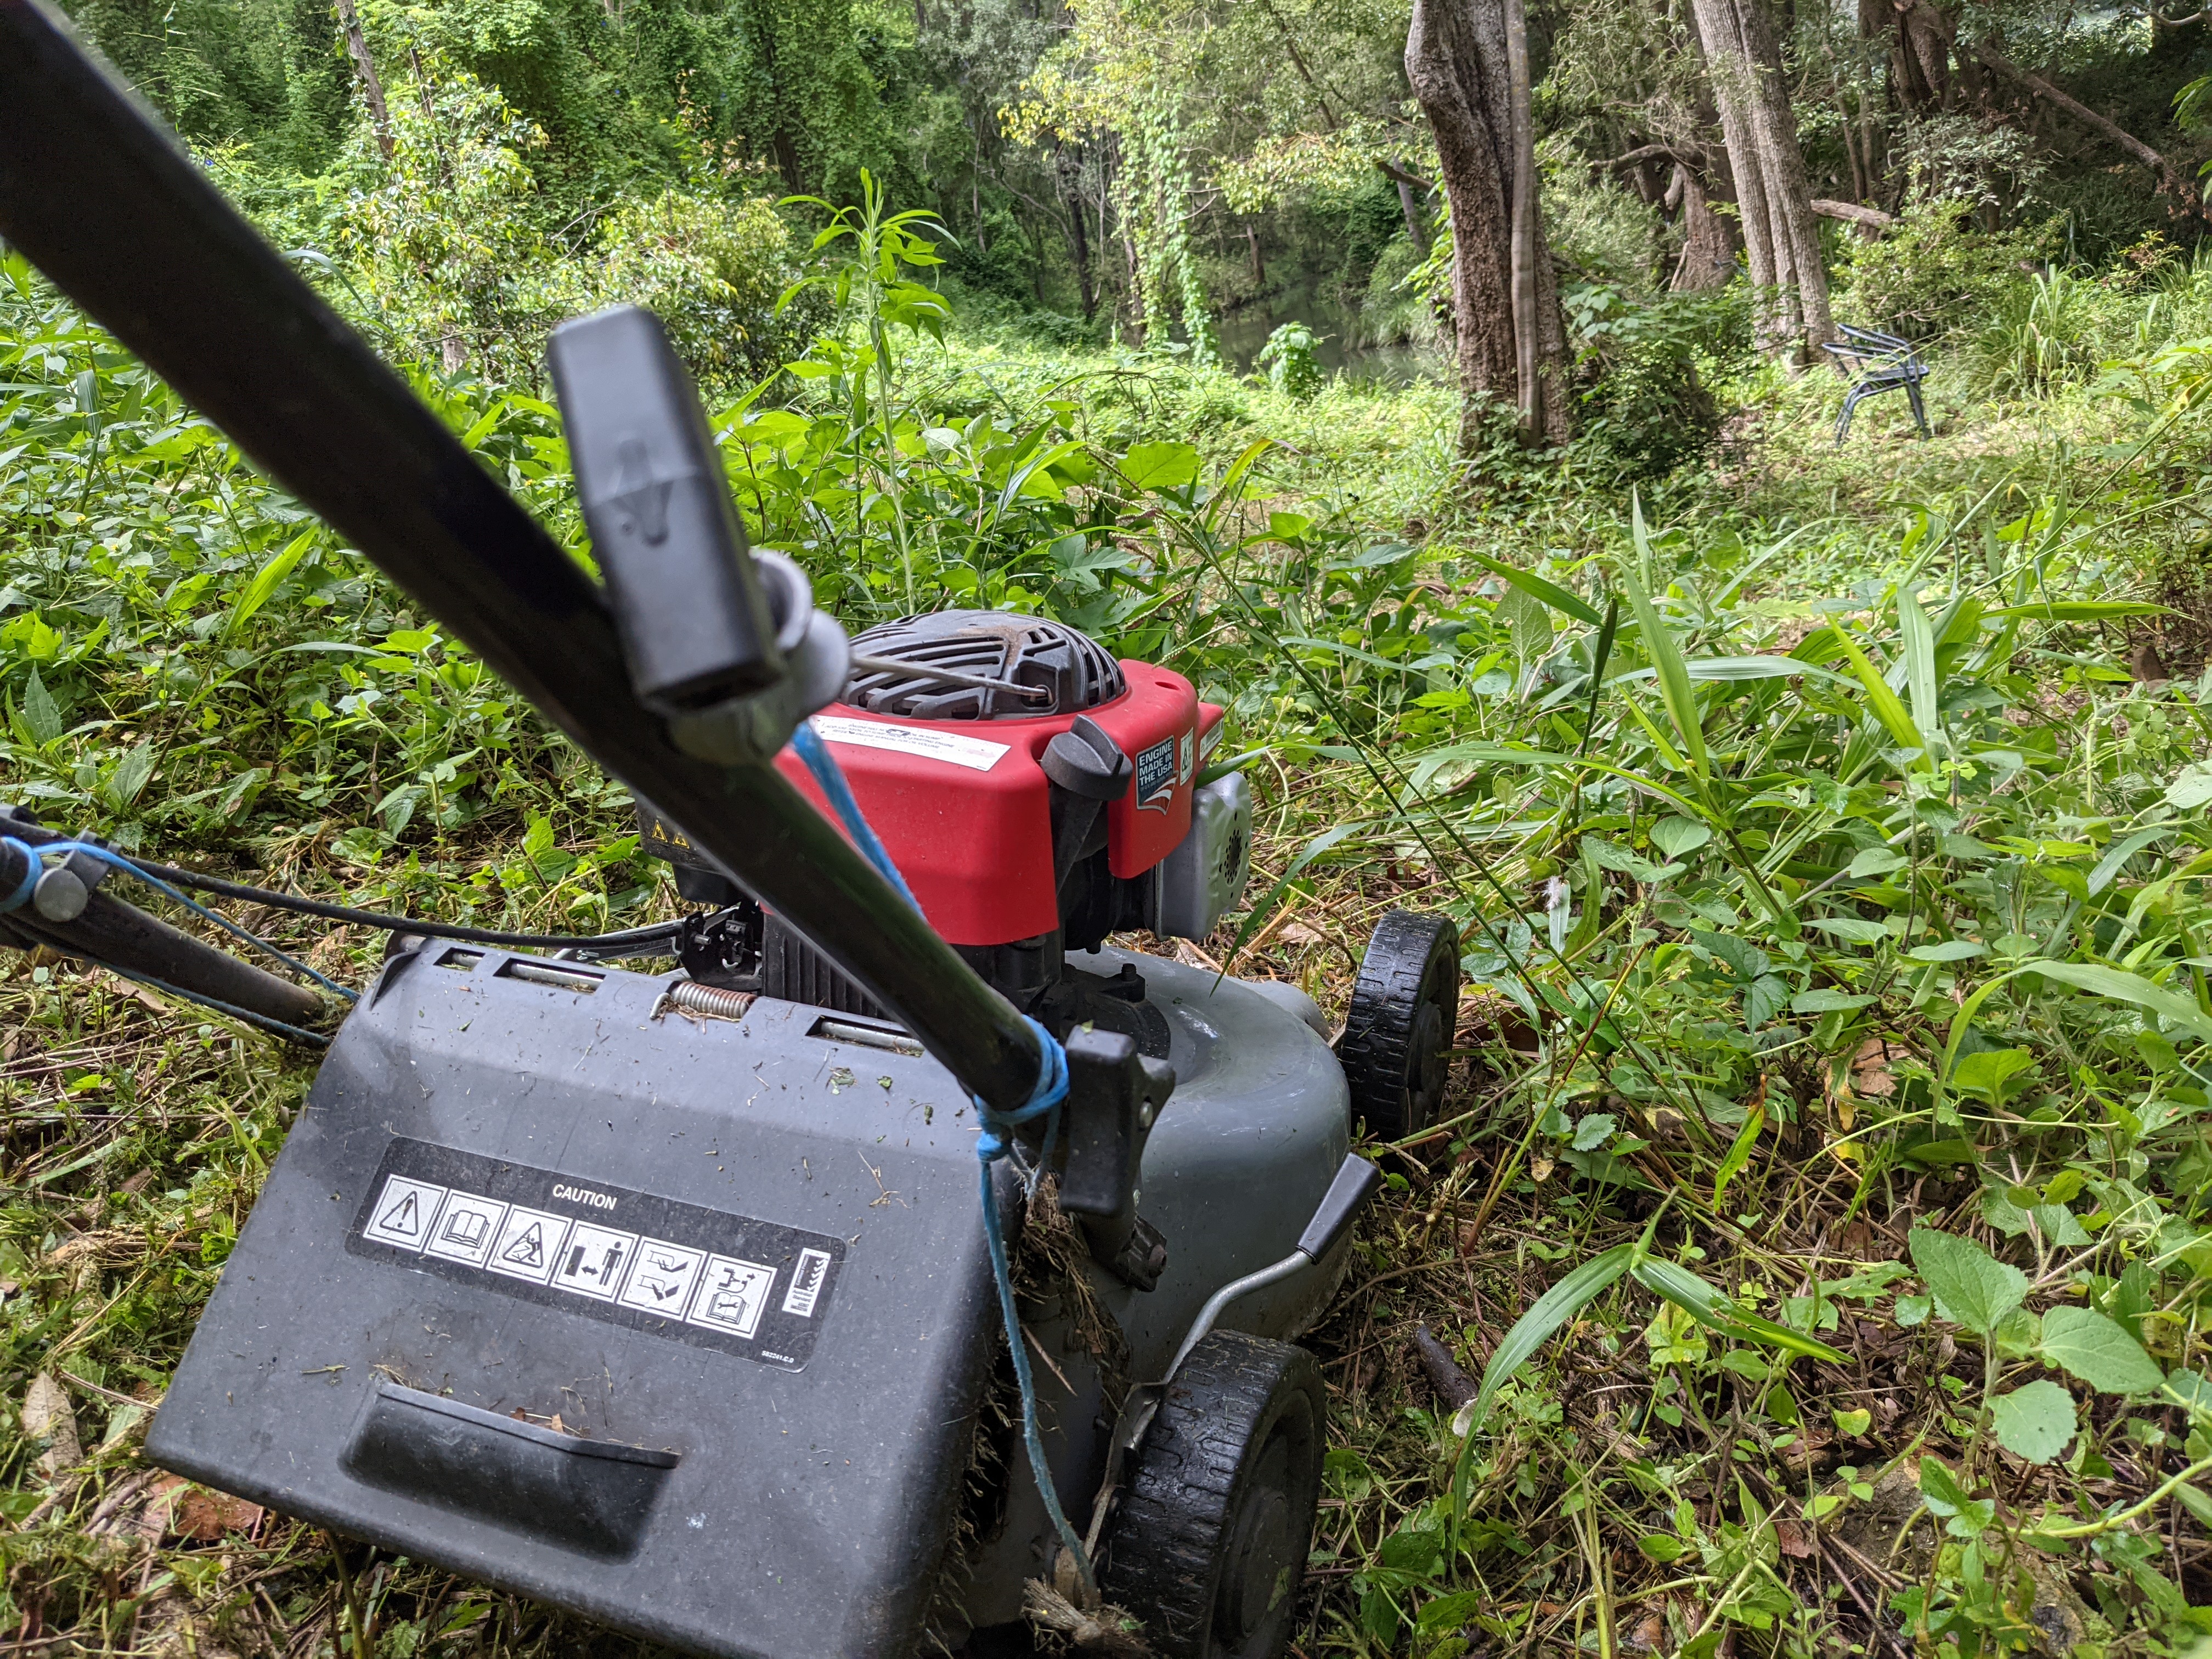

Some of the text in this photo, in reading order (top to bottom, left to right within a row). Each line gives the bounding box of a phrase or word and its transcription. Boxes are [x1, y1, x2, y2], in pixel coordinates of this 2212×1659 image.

[1139, 741, 1172, 766] ENGINE
[1139, 757, 1163, 777] MADE
[1165, 752, 1172, 764] IN
[1139, 771, 1156, 786] THE
[1158, 761, 1172, 776] USA
[552, 1184, 618, 1210] CAUTION
